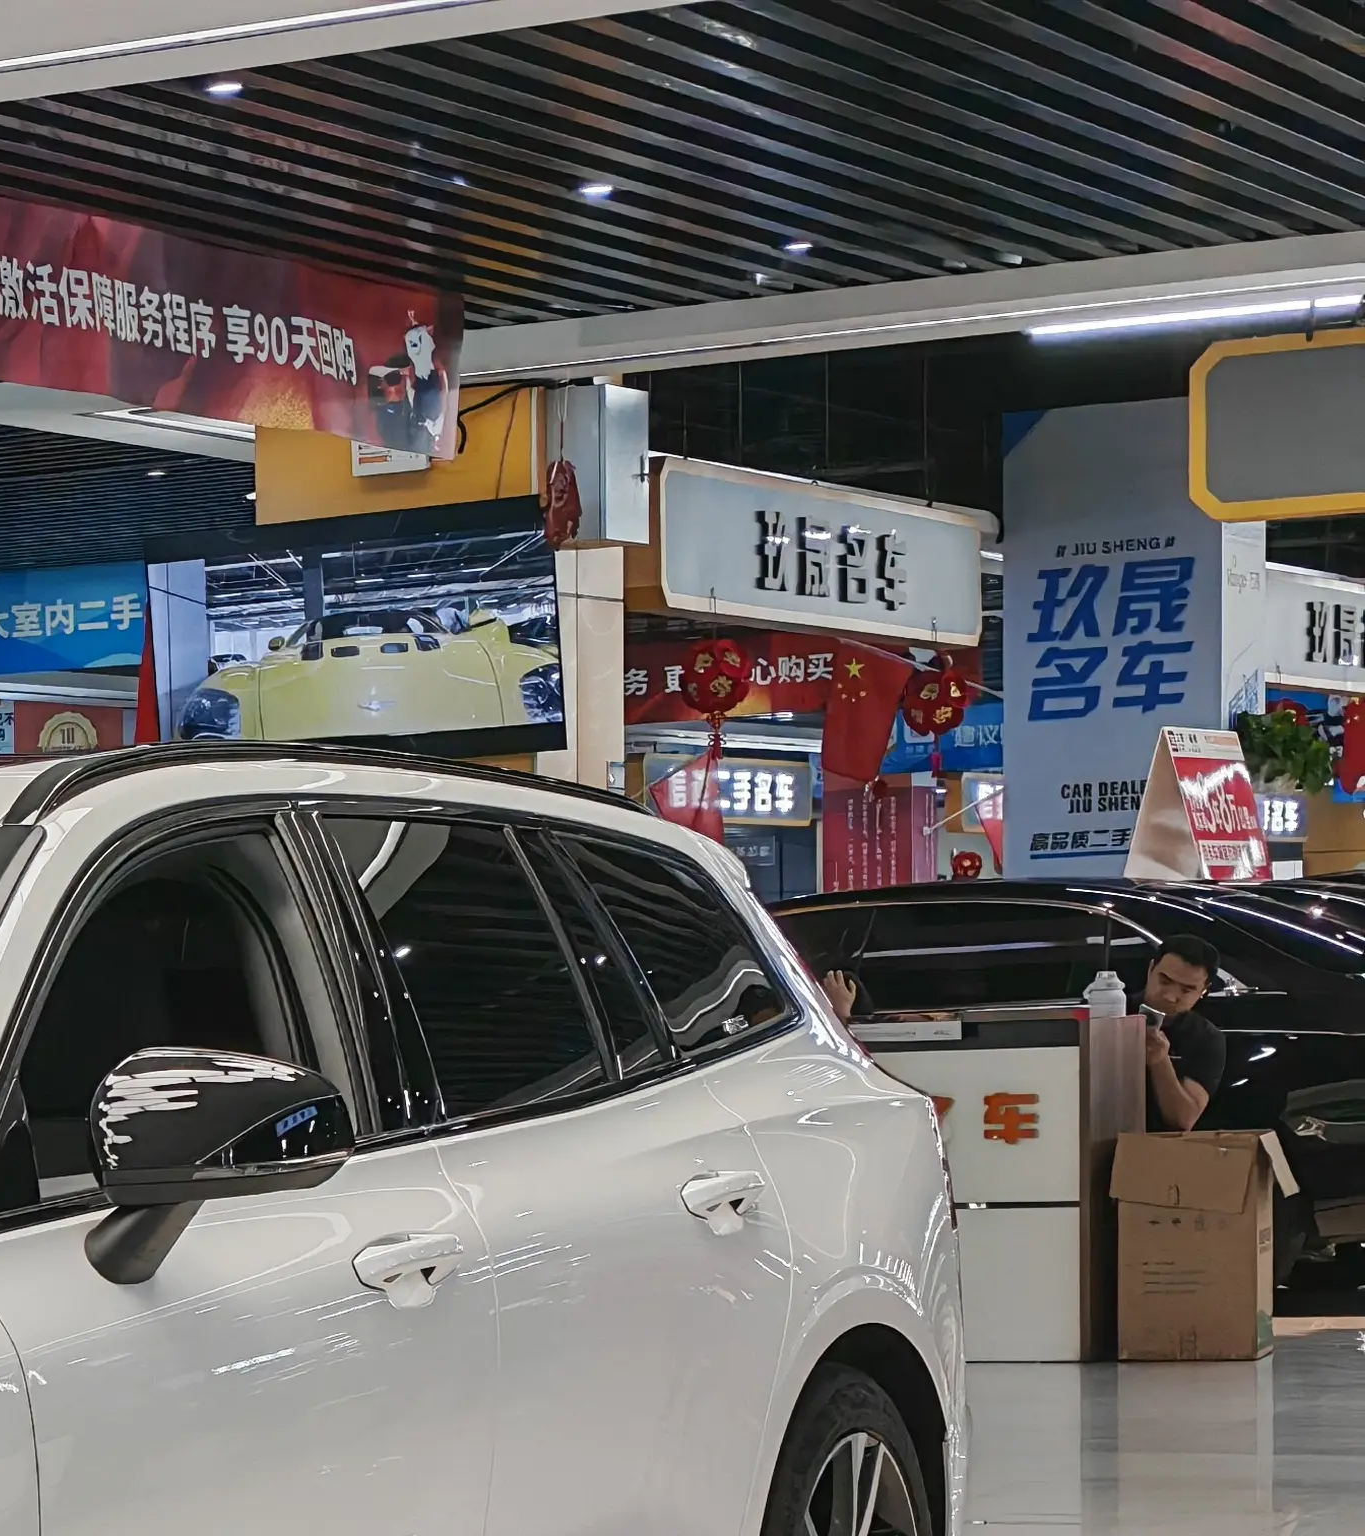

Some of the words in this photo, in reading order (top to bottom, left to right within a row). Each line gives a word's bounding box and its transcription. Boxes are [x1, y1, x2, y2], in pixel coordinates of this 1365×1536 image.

[223, 304, 358, 386] 享90天回购
[754, 511, 907, 611] 玖晟名车
[1072, 540, 1097, 557] JIU
[1101, 537, 1161, 555] SHENG
[1027, 556, 1195, 643] 玖晟
[1305, 601, 1365, 668] 玖晟
[1027, 641, 1195, 721] 名车
[954, 724, 1003, 747] 建议
[1060, 783, 1093, 799] CAR
[1068, 799, 1093, 814] JIU
[1030, 828, 1132, 851] 高品质二手
